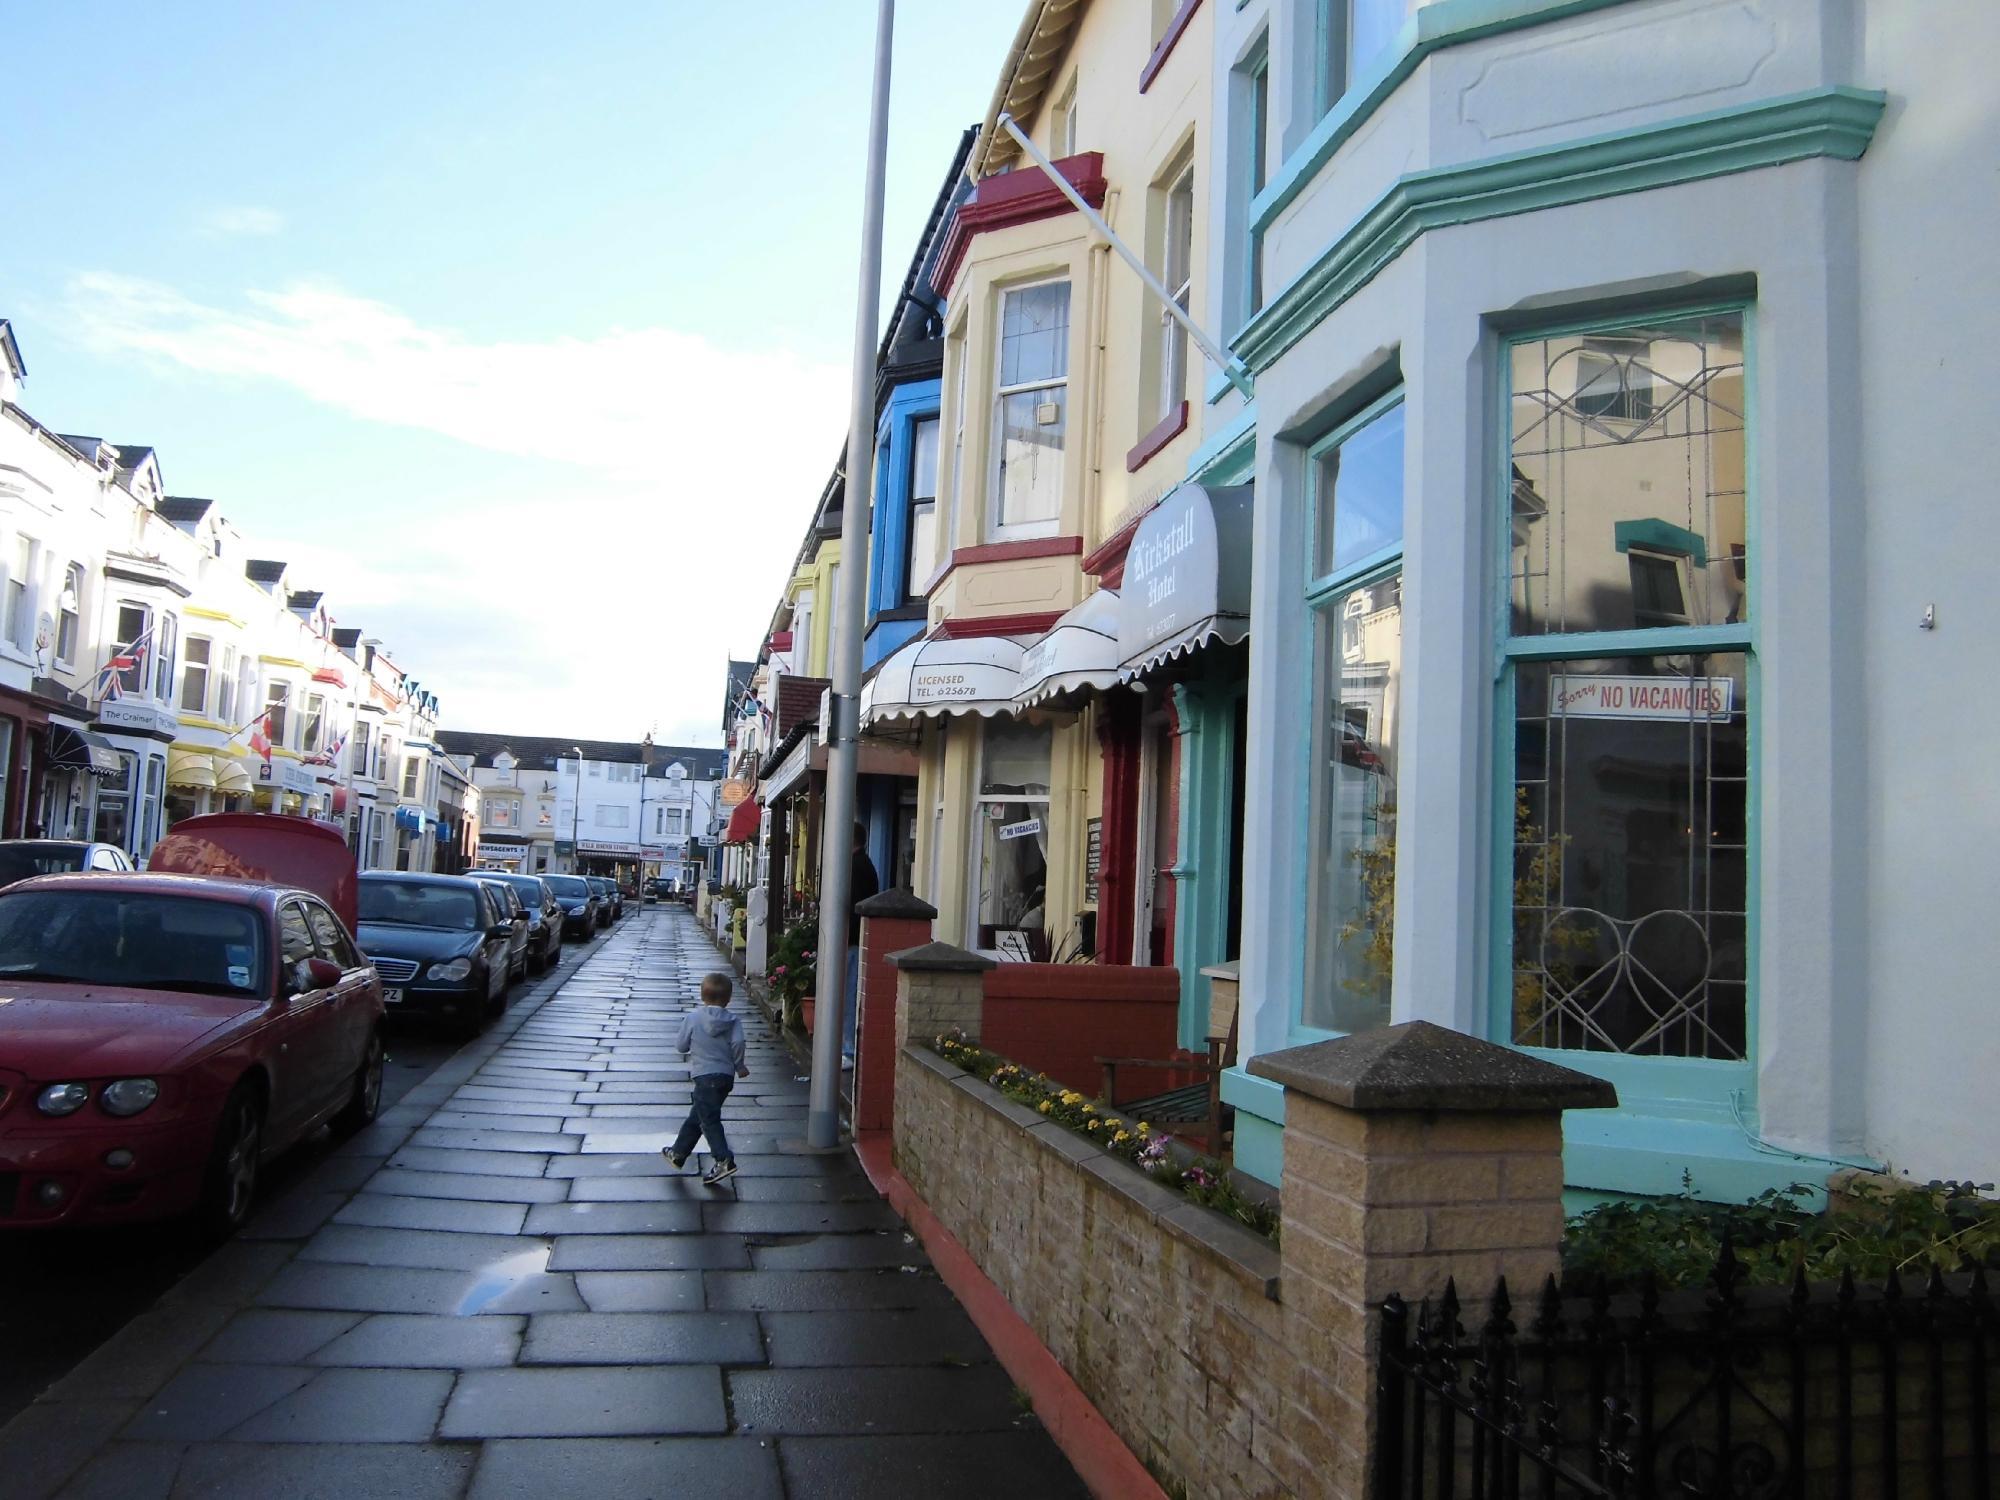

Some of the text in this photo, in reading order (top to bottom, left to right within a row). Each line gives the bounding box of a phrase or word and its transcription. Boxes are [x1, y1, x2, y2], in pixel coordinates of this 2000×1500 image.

[1134, 505, 1194, 582] Kirkstall
[1147, 566, 1176, 608] Hotel
[918, 675, 964, 685] LICENSED
[917, 686, 977, 697] TEL. 625678
[1557, 683, 1721, 712] Sorry NO VACANCIES
[105, 710, 121, 719] The
[477, 845, 518, 853] NEWSAGENTS
